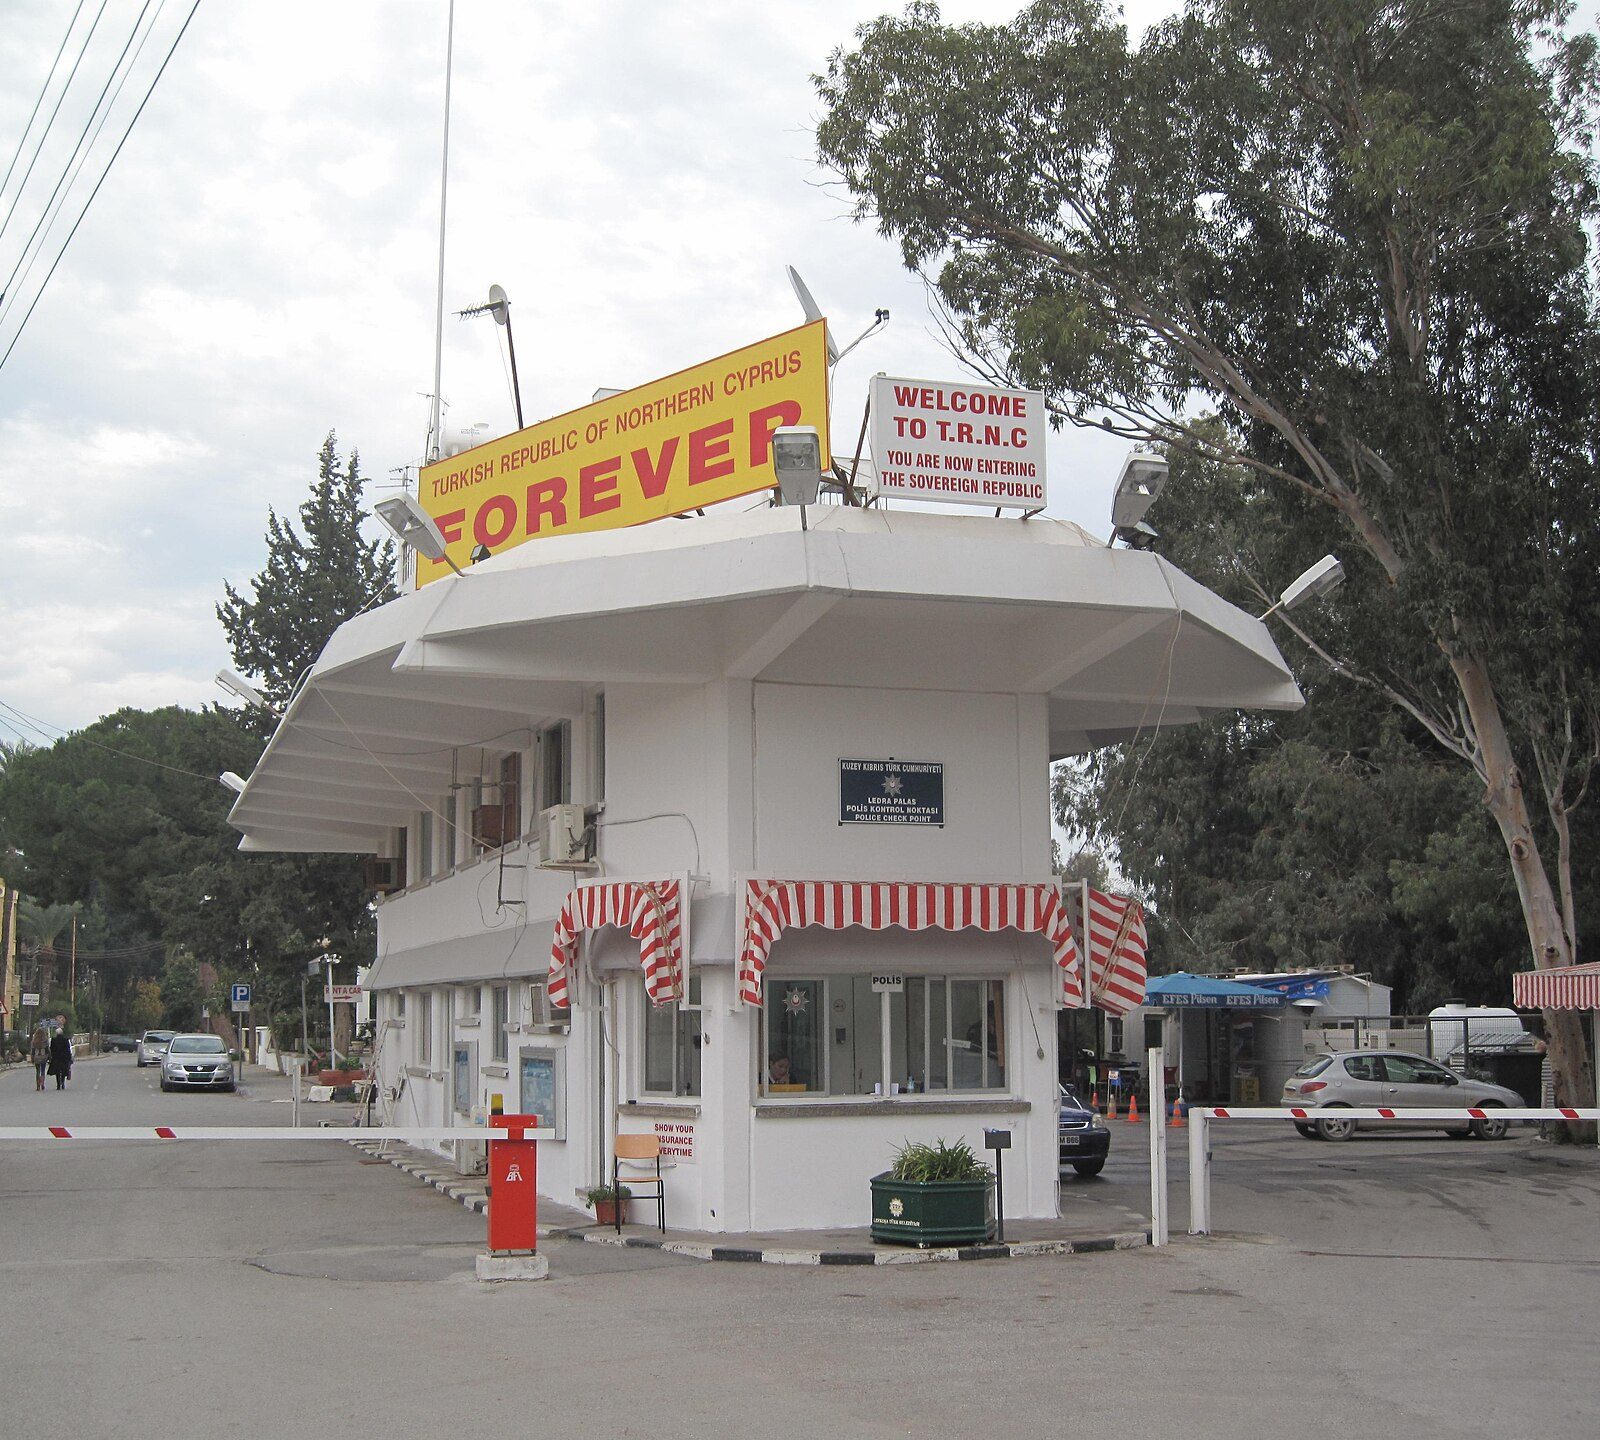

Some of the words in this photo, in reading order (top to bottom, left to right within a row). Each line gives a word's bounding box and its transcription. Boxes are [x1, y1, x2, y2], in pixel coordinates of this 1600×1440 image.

[894, 385, 1026, 418] WELCOME
[432, 459, 494, 497] TURKISH
[500, 429, 577, 473] REPUBLIC
[586, 418, 609, 445] OF
[616, 381, 714, 434] NORTHERN
[723, 350, 802, 396] CYPRUS
[893, 416, 927, 440] TO
[936, 420, 1028, 448] T.R.N.C
[887, 450, 912, 466] YOU
[916, 453, 940, 469] ARE
[944, 455, 973, 472] NOW
[977, 458, 1036, 477] ENTERING
[432, 399, 802, 565] FOREVER
[881, 471, 905, 487] THE
[910, 473, 978, 493] SOVEREIGN
[983, 480, 1043, 499] REPUBLIC
[842, 762, 861, 771] KUZEY
[863, 763, 884, 771] KIBRIS
[885, 763, 901, 772] TÜRK
[868, 797, 892, 805] LEDRA
[846, 804, 868, 812] POLİS
[873, 975, 902, 985] POLİS
[1162, 994, 1189, 1005] EFES
[1190, 993, 1218, 1005] Pilsen
[1226, 995, 1253, 1006] EFES
[1253, 994, 1280, 1006] Pilsen
[654, 1123, 674, 1132] SHOW
[675, 1124, 694, 1134] YOUR
[656, 1135, 693, 1145] NSURANCE
[658, 1146, 693, 1157] VERYTIME
